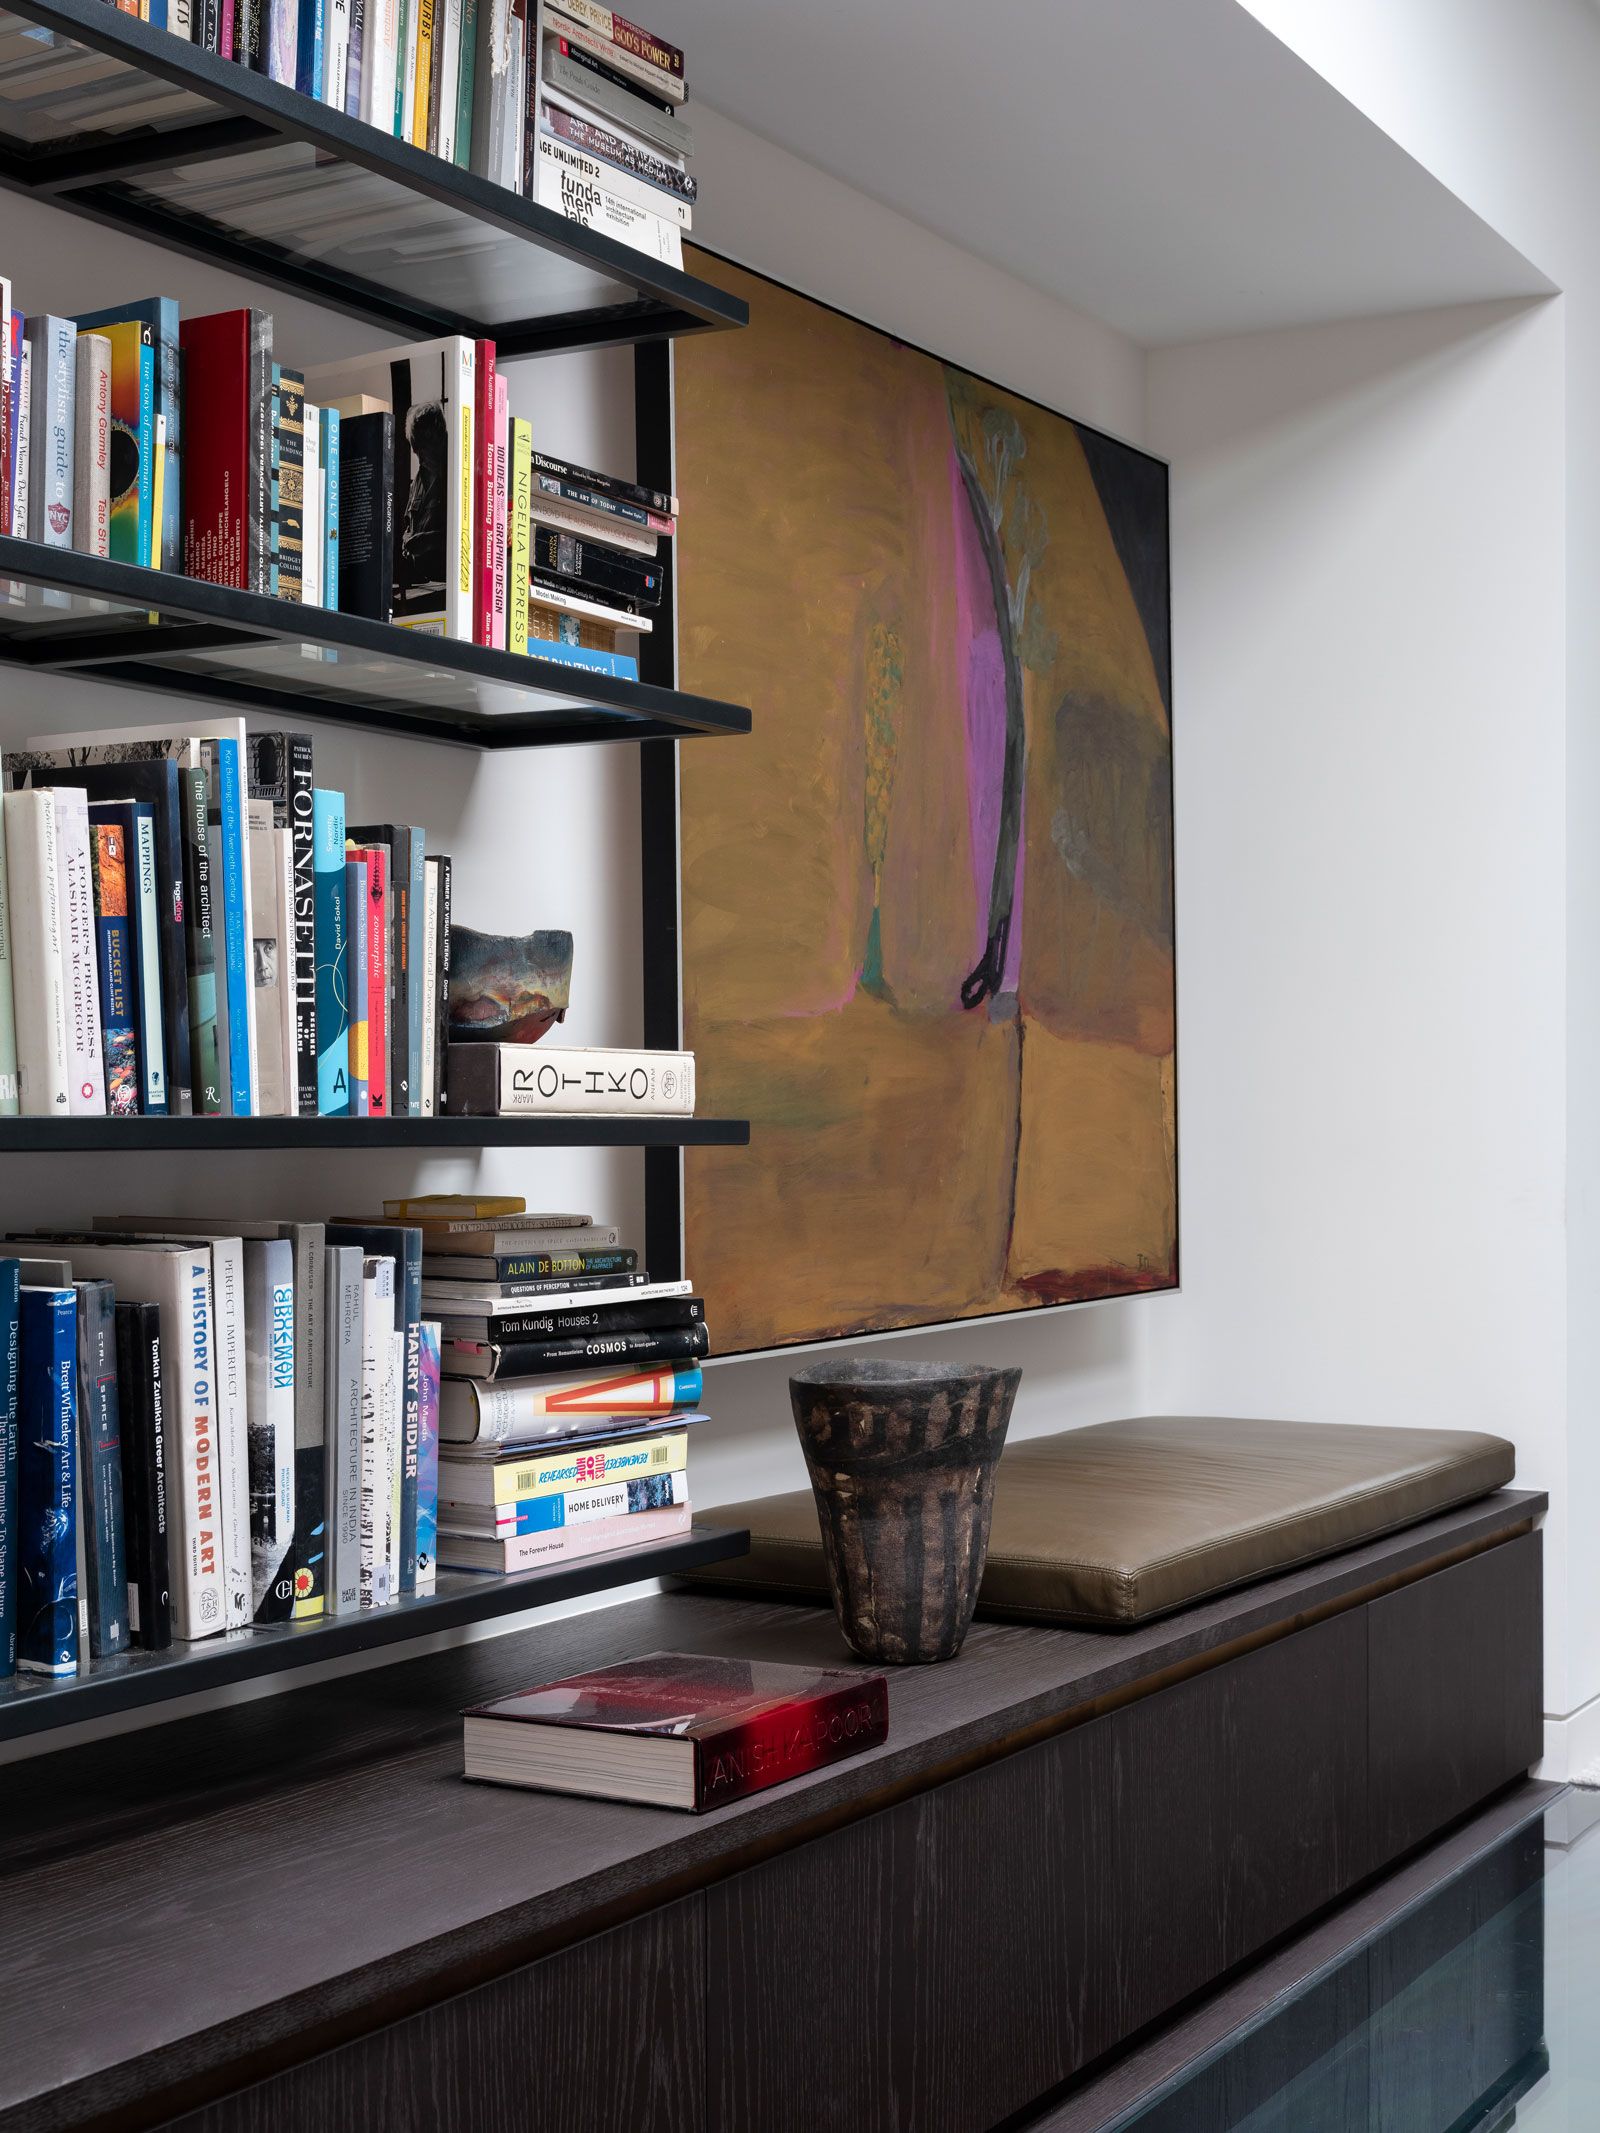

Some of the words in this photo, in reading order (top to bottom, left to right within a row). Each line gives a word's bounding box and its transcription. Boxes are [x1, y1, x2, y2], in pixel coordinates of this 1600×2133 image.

[590, 9, 612, 30] PRINCE
[572, 27, 599, 49] Architects
[614, 26, 639, 52] GOD'S
[641, 39, 670, 70] POWER
[554, 145, 593, 175] UNLIMITED
[595, 166, 600, 178] 2
[569, 127, 584, 140] THE
[589, 136, 621, 157] MUSEUM
[625, 155, 635, 163] AS
[570, 118, 588, 130] ART
[595, 128, 616, 145] AND
[621, 143, 667, 169] ARTIFACT
[561, 170, 602, 206] funda
[561, 191, 593, 216] men
[606, 212, 629, 227] exhibition
[58, 331, 70, 359] the
[54, 361, 70, 423] stylists
[97, 370, 108, 413] Antony
[168, 373, 174, 382] TO
[54, 426, 68, 478] guide
[96, 417, 107, 469] Gormley
[330, 424, 338, 456] ONE
[496, 445, 505, 463] 100
[486, 442, 494, 475] House
[535, 454, 568, 475] Discourse
[55, 481, 65, 498] to
[496, 464, 505, 497] IDEAS
[98, 499, 107, 524] Tate
[329, 480, 338, 519] ONLY
[386, 492, 394, 533] Mecanoo
[486, 481, 494, 525] Building
[517, 471, 528, 559] NIGELLA
[567, 489, 578, 498] THE
[580, 492, 590, 502] ART
[600, 500, 616, 511] TODAY
[98, 528, 107, 542] St
[495, 522, 505, 572] GRAPHIC
[495, 574, 505, 614] DESIGN
[515, 563, 526, 644] EXPRESS
[536, 589, 550, 600] Model
[551, 593, 566, 605] Making
[194, 780, 204, 800] the
[195, 804, 206, 841] house
[77, 848, 85, 858] A
[140, 822, 153, 895] MAPPINGS
[198, 845, 208, 858] of
[199, 861, 209, 881] the
[293, 767, 315, 1007] FORNASETTI
[67, 853, 80, 945] ALASDAIR
[77, 865, 92, 956] FORGER'S
[200, 885, 212, 939] architect
[444, 901, 450, 912] OF
[334, 925, 342, 950] David
[371, 915, 382, 979] zoomorphic
[111, 929, 123, 985] BUCKET
[82, 959, 96, 1059] PROGRESS
[114, 989, 124, 1017] LIST
[303, 1028, 309, 1040] OF
[309, 1010, 317, 1056] DESIGNER
[512, 1065, 649, 1099] ROTHKO
[191, 1265, 204, 1279] A
[508, 1263, 535, 1276] ALAIN
[538, 1262, 549, 1274] DE
[551, 1259, 586, 1273] BOTTON
[224, 1259, 234, 1319] PERFECT
[352, 1284, 360, 1321] RAHUL
[511, 1284, 535, 1294] QUESTIONS
[536, 1284, 542, 1292] OF
[543, 1282, 570, 1291] PERCEPTION
[192, 1287, 208, 1371] HISTORY
[343, 1284, 352, 1345] MEHROTRA
[500, 1321, 520, 1333] Tom
[522, 1318, 554, 1332] Kundig
[558, 1316, 590, 1328] Houses
[592, 1313, 599, 1325] 2
[6, 1320, 19, 1393] Designing
[151, 1337, 161, 1378] Tonkin
[225, 1323, 237, 1399] IMPERFECT
[407, 1322, 420, 1395] HARRY
[586, 1341, 627, 1355] COSMOS
[61, 1360, 71, 1391] Brett
[194, 1380, 209, 1407] OF
[421, 1375, 430, 1403] John
[8, 1396, 18, 1420] the
[59, 1391, 72, 1447] Whiteley
[100, 1384, 108, 1432] SPACE
[153, 1380, 163, 1434] Zulaikha
[421, 1404, 430, 1442] Maeda
[7, 1423, 18, 1461] Earth
[349, 1379, 357, 1483] ARCHITECTURE
[405, 1399, 418, 1479] SEIDLER
[61, 1449, 71, 1471] Art
[155, 1435, 165, 1468] Greer
[194, 1415, 212, 1521] MODERN
[61, 1472, 71, 1481] &
[349, 1486, 356, 1501] IN
[538, 1467, 579, 1484] REHEARSED
[61, 1483, 71, 1508] Life
[156, 1471, 167, 1534] Architects
[568, 1500, 590, 1513] HOME
[591, 1494, 625, 1509] DELIVERY
[348, 1504, 356, 1543] INDIA
[199, 1530, 214, 1575] ART
[519, 1548, 529, 1557] The
[530, 1544, 548, 1555] Forever
[548, 1542, 564, 1551] House
[711, 1742, 779, 1789] ANISH
